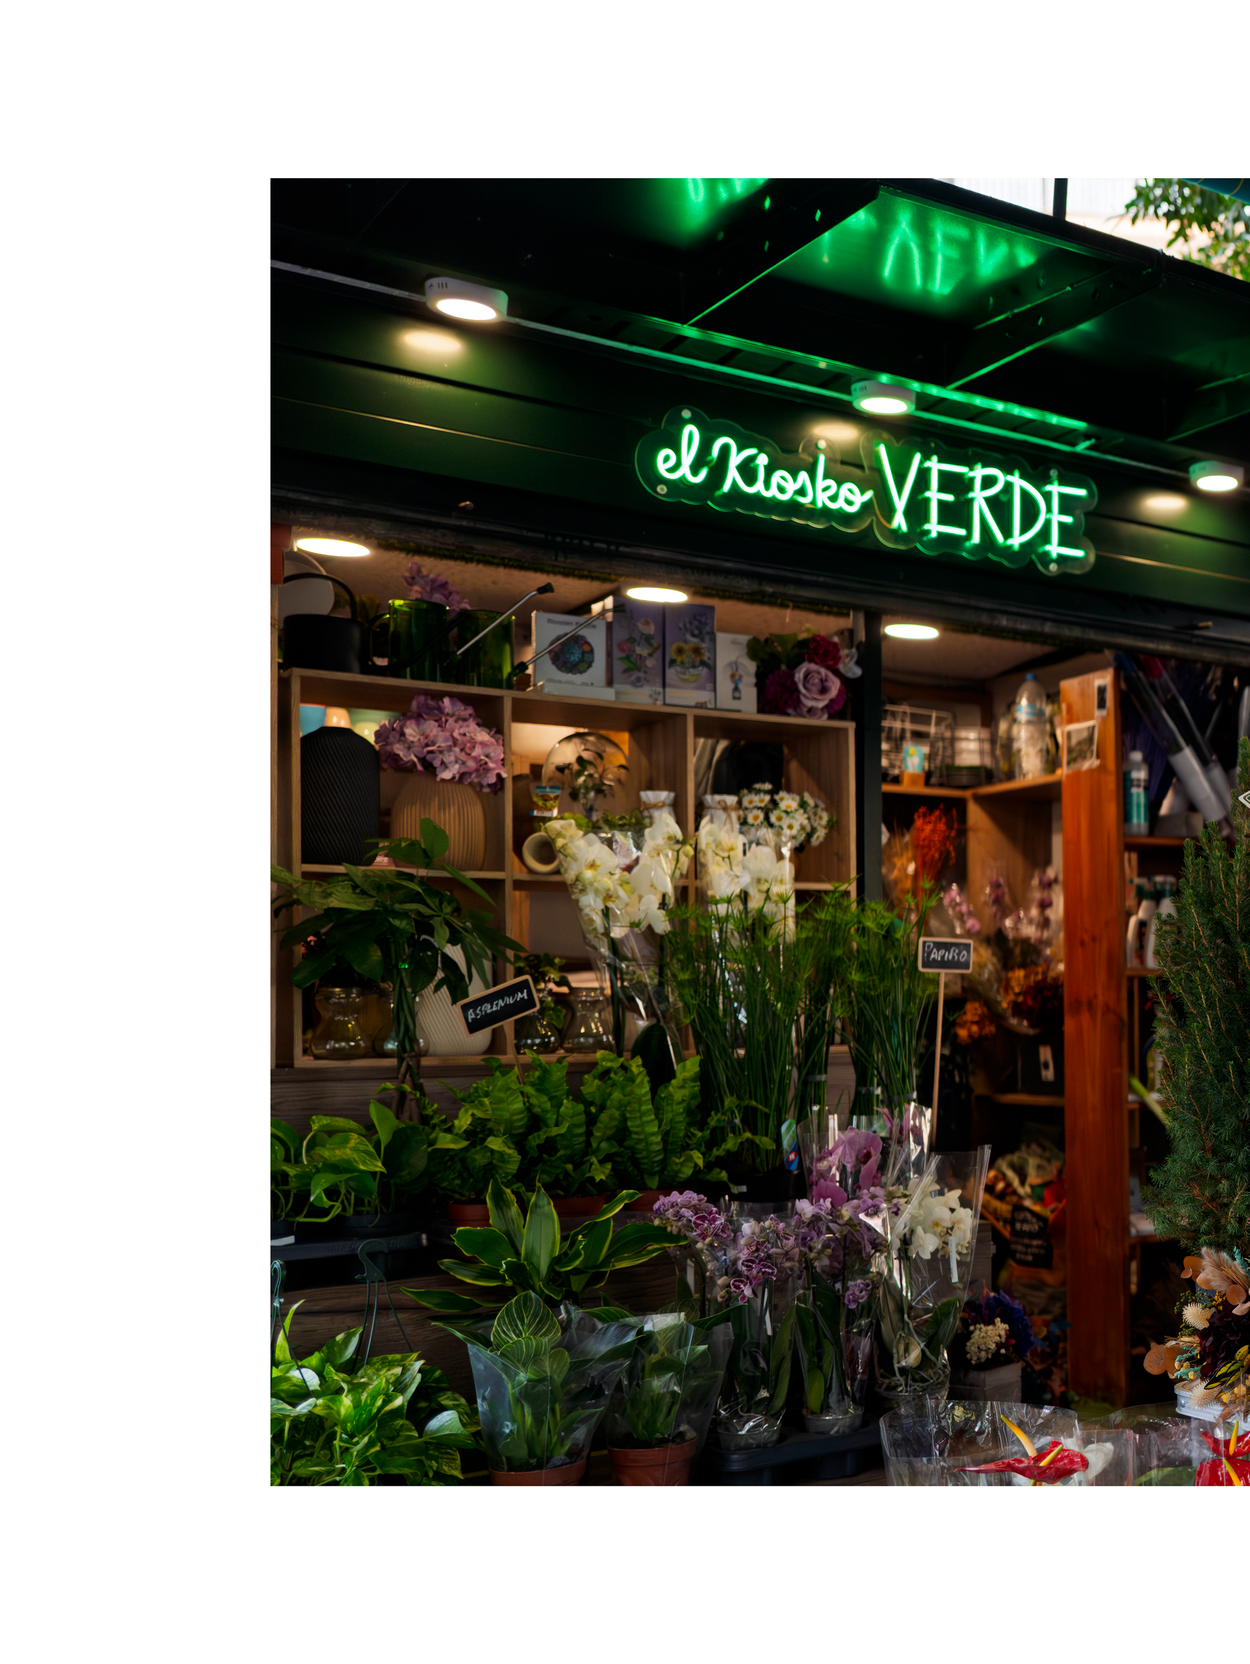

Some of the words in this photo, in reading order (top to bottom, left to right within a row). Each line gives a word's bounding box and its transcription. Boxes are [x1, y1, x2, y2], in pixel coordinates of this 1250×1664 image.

[656, 424, 709, 483] el
[713, 436, 874, 513] Kiosko
[878, 441, 1089, 558] VERDE
[467, 989, 529, 1023] ASPLENIUM
